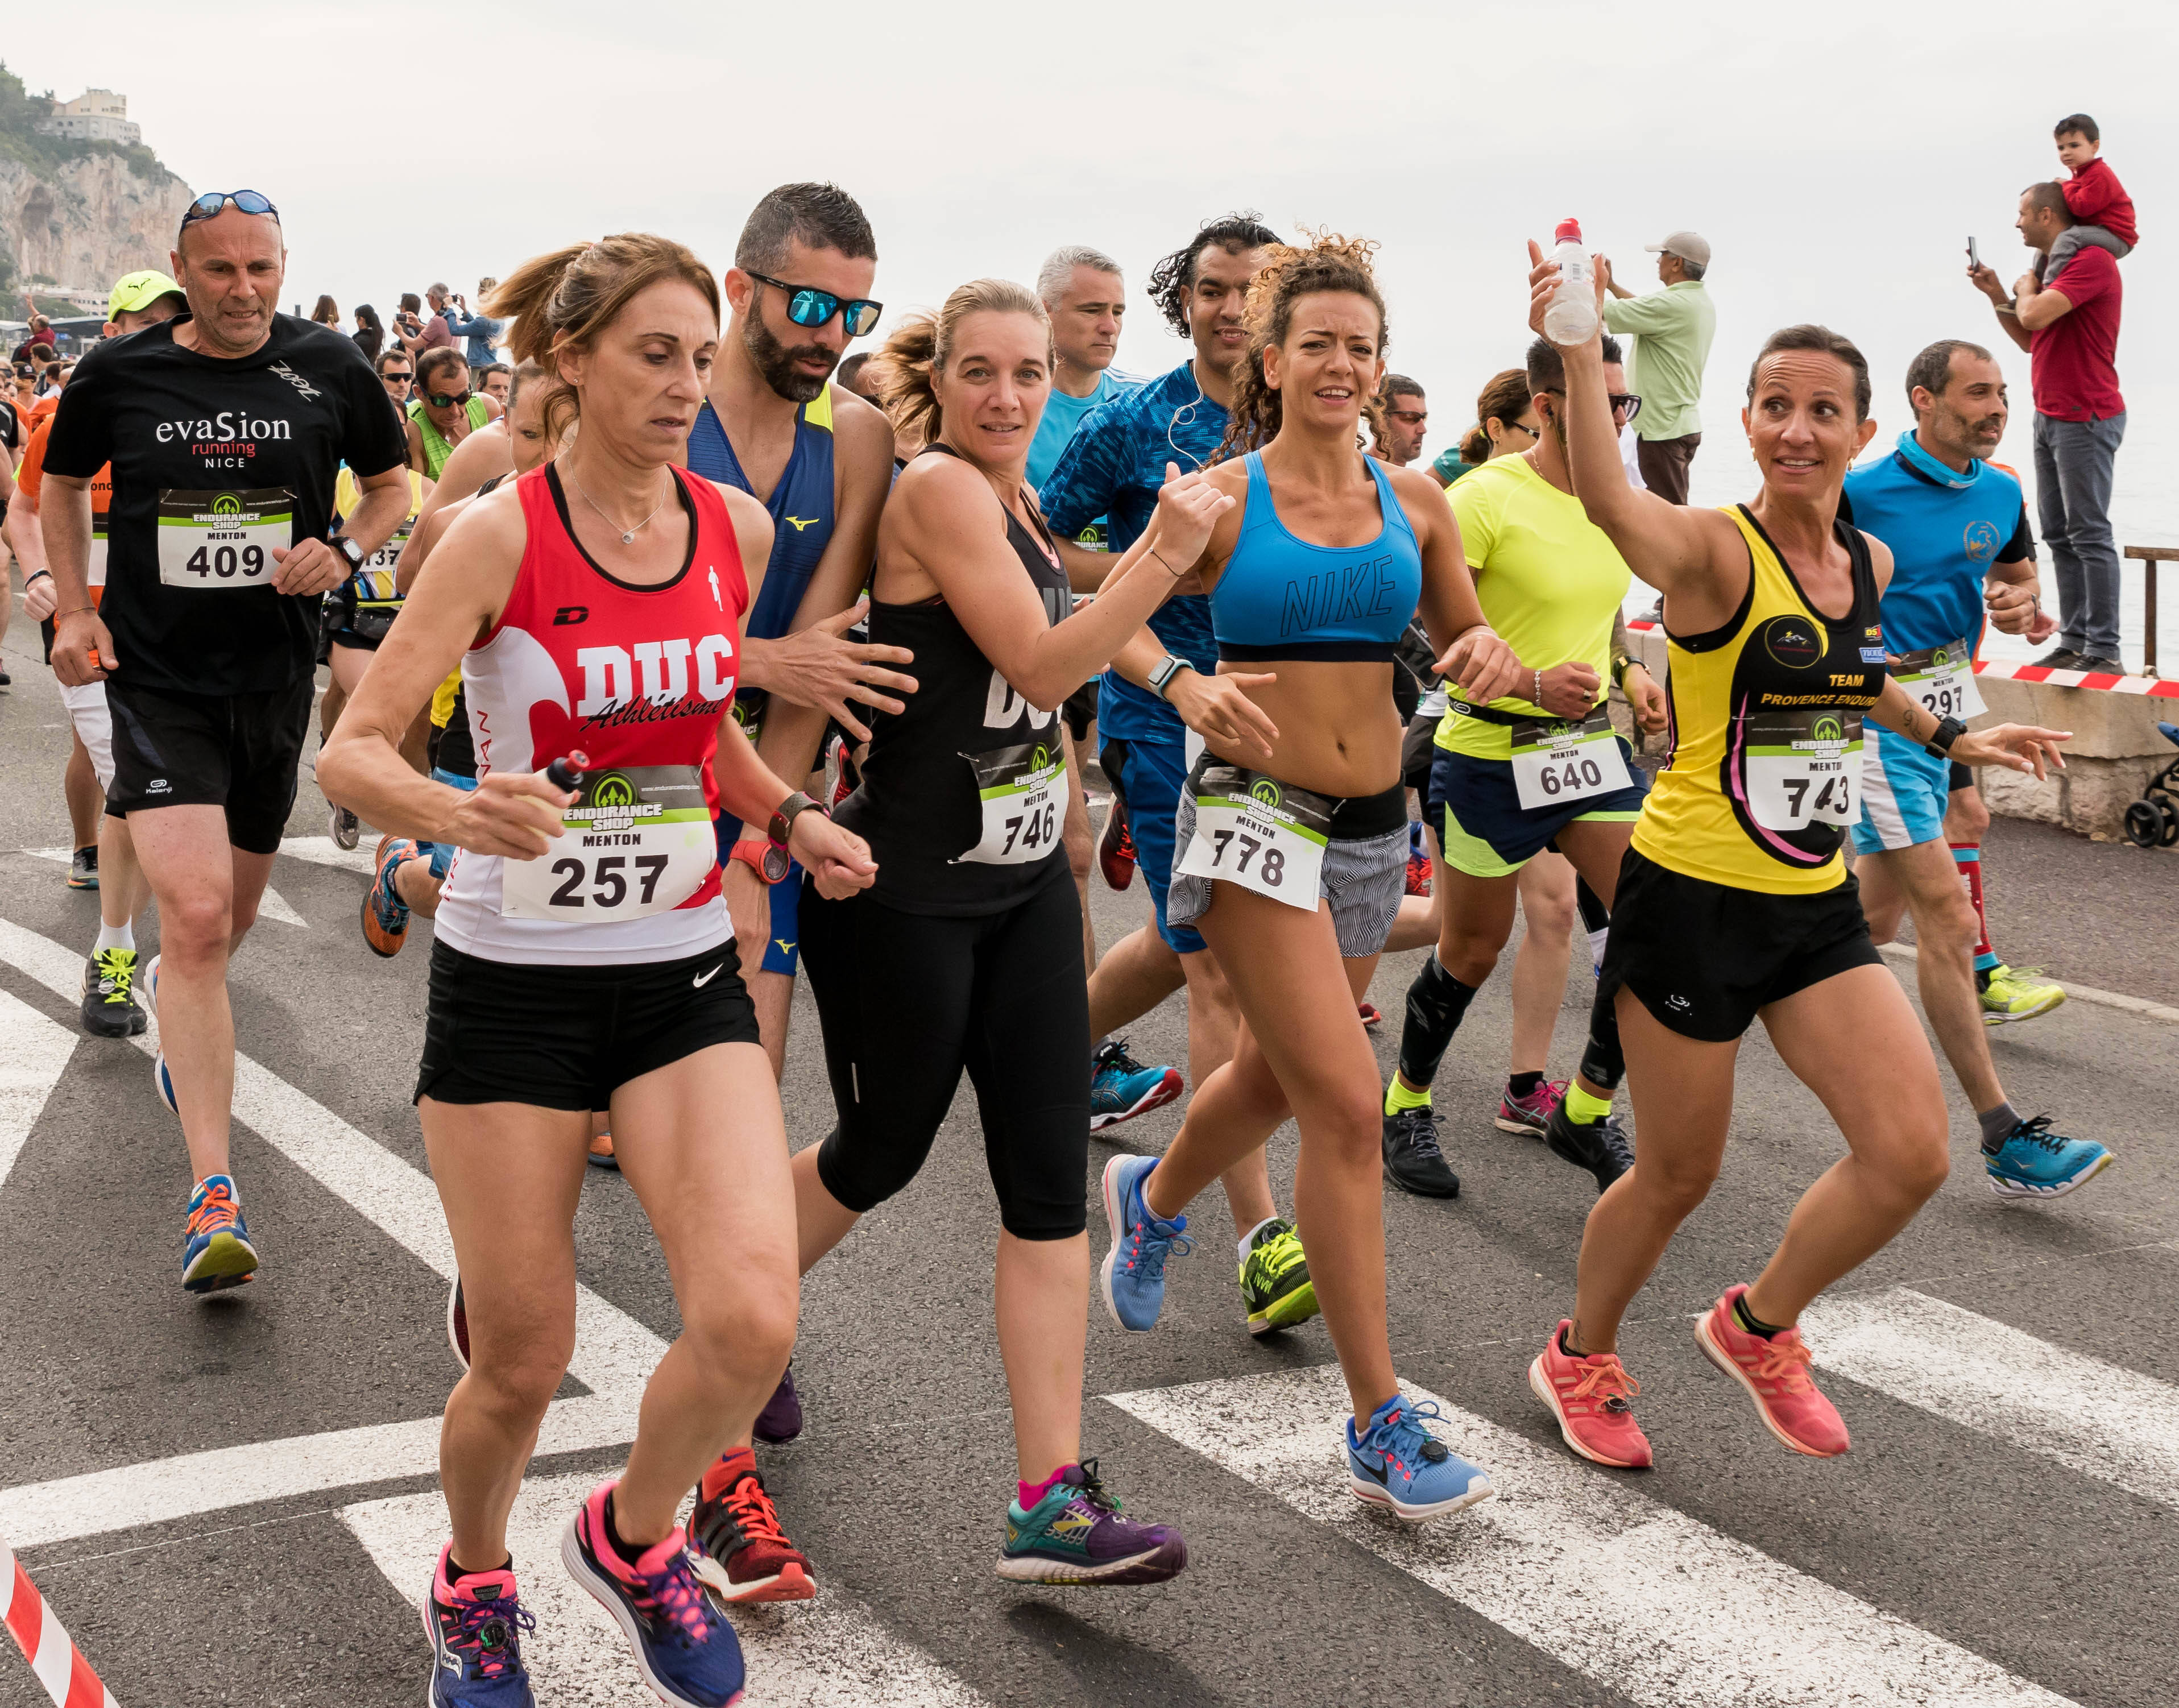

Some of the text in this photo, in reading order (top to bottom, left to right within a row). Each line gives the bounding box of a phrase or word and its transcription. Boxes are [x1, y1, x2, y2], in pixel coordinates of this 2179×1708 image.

[156, 411, 292, 442] evaSion
[192, 440, 255, 458] running
[205, 458, 245, 468] NICE
[193, 513, 260, 523] ENDURANCE
[212, 521, 241, 530] SHOP
[186, 545, 264, 578] 409
[1281, 554, 1395, 637] NIKE
[577, 633, 735, 718] DUC
[1829, 674, 1865, 686] TEAM
[578, 693, 724, 732] Athlétisme
[1760, 693, 1879, 706] PROVENCE ENDUR
[1921, 686, 1962, 715] 297
[1550, 749, 1579, 760] MENTON
[1540, 759, 1602, 795] 640
[1228, 792, 1297, 826] ENDURANCE
[1783, 776, 1849, 818] 743
[563, 803, 663, 820] ENDURANCE
[592, 817, 635, 831] SHOP
[1245, 805, 1276, 824] SHOP
[1000, 802, 1055, 856] 746
[1236, 815, 1276, 839] MENTON
[582, 834, 641, 847] MENTON
[1212, 829, 1285, 887] 778
[549, 854, 669, 908] 257
